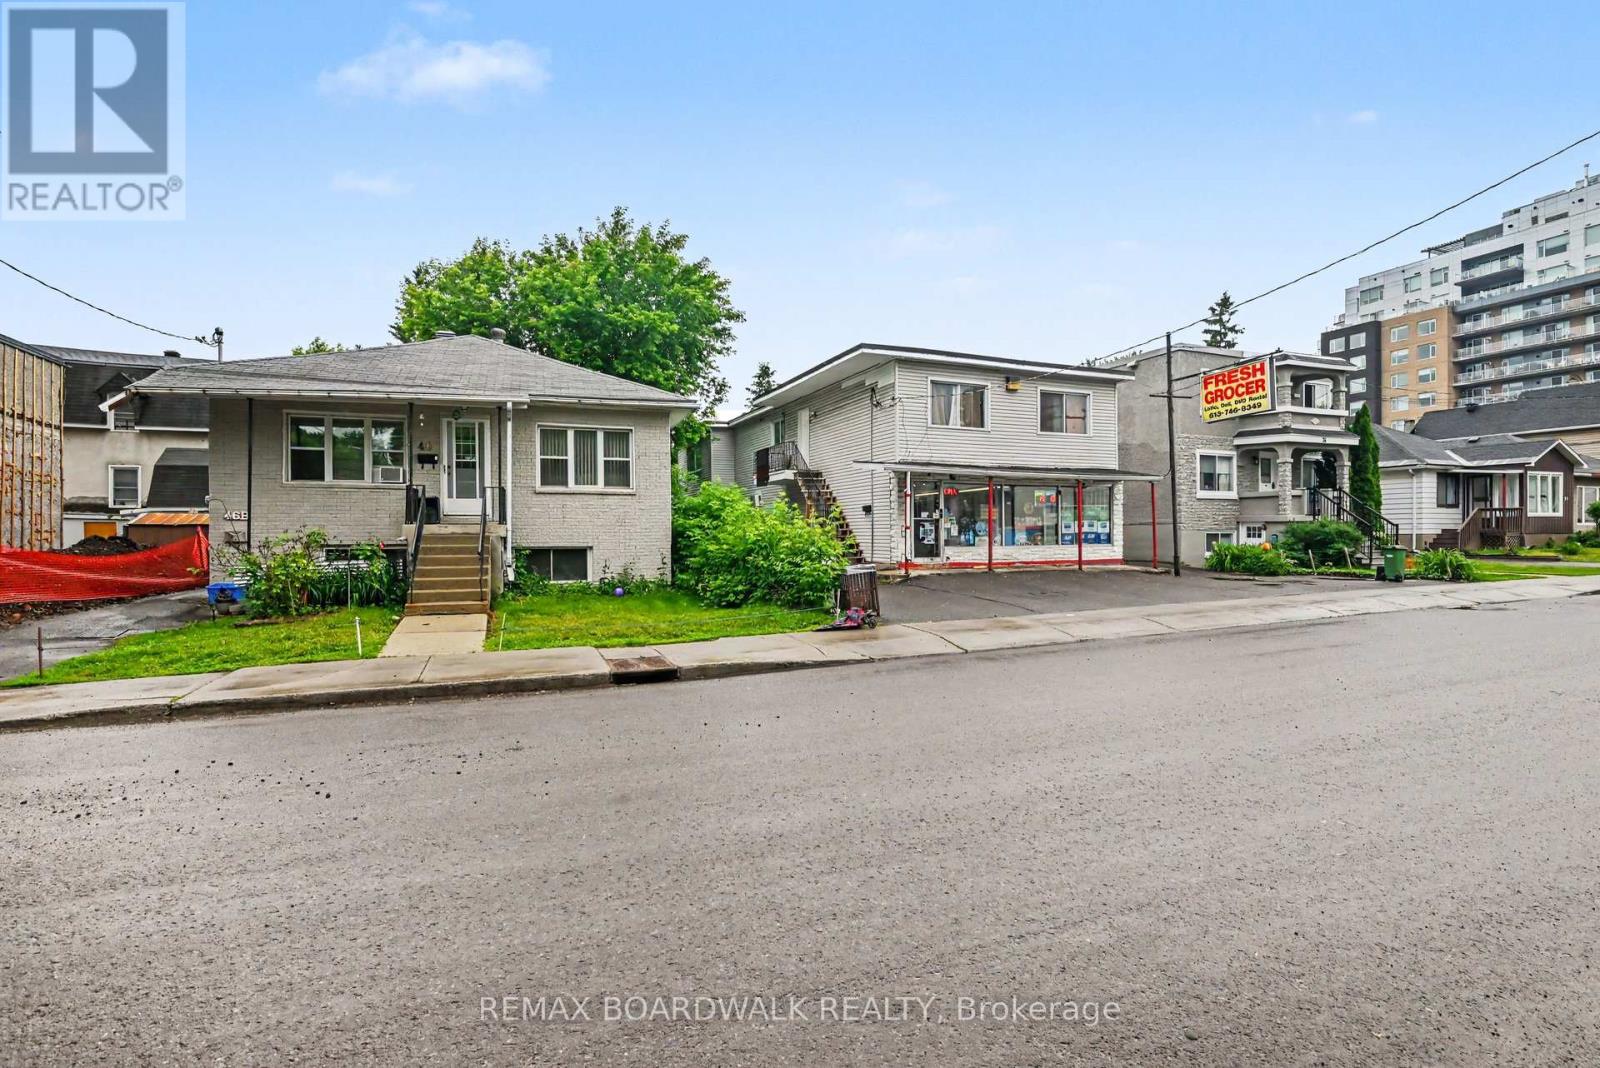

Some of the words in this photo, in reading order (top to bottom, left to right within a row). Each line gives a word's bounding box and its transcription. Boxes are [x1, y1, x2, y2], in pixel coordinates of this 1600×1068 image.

[1203, 362, 1265, 391] FRESH
[1204, 378, 1266, 405] GROCER
[1208, 402, 1262, 419] 613-746-8349
